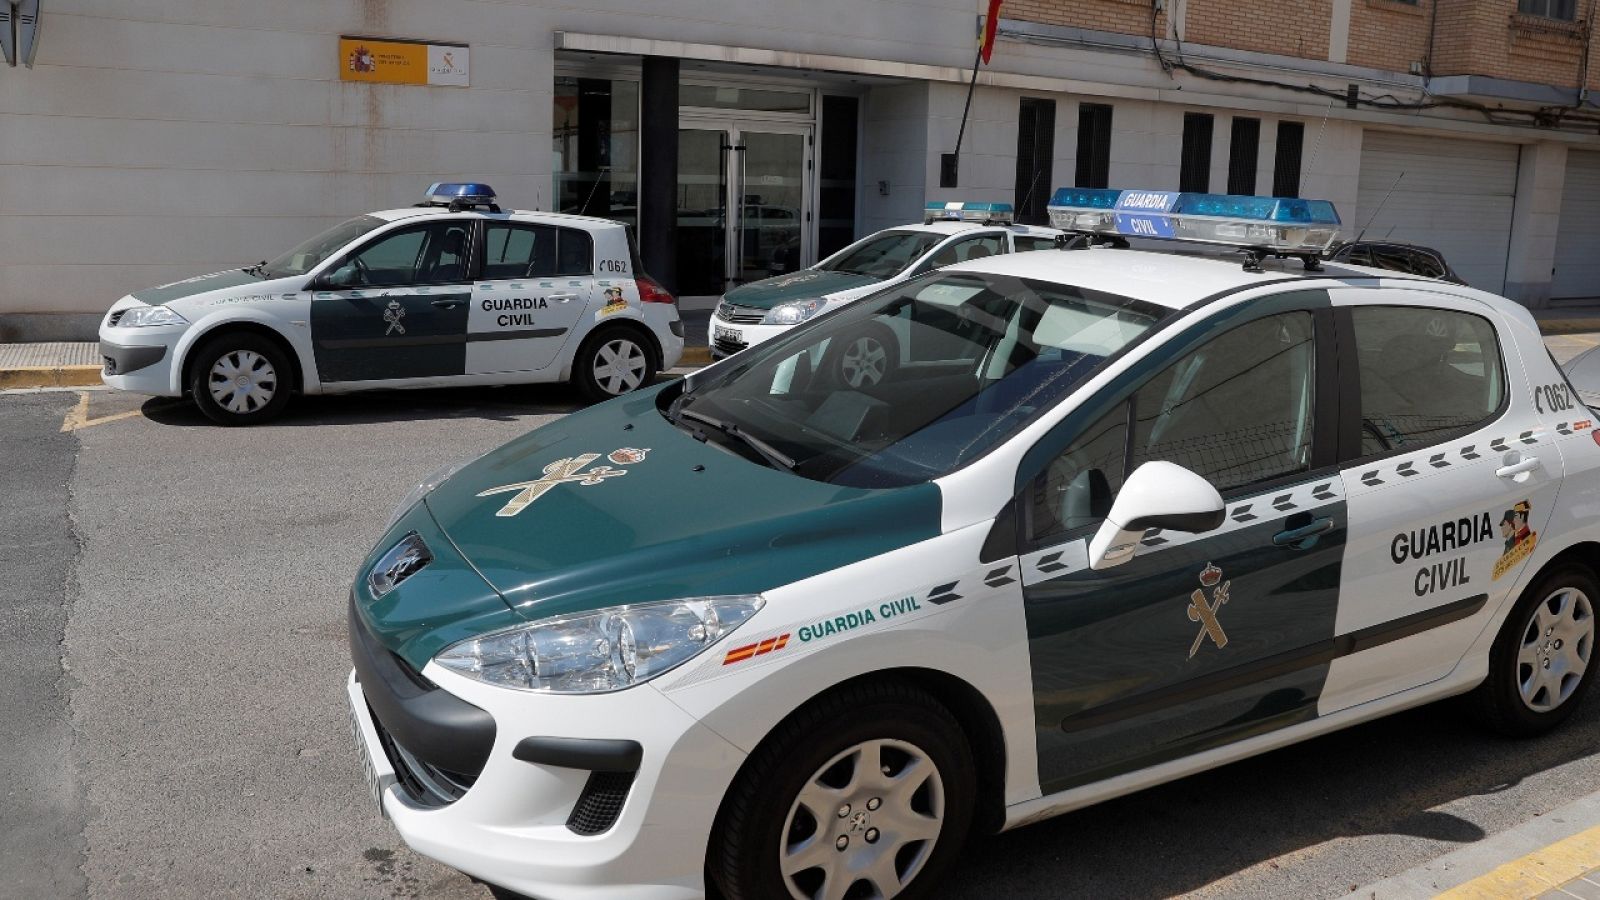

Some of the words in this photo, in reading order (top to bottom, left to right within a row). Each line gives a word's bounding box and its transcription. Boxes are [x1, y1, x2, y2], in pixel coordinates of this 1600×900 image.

[1124, 193, 1168, 209] GUARDIA
[1131, 218, 1158, 235] CIVIL
[608, 260, 627, 273] 062
[481, 297, 548, 311] GUARDIA
[497, 313, 535, 326] CIVIL
[1544, 383, 1574, 412] 062
[1391, 512, 1493, 564] GUARDIA
[1414, 557, 1470, 597] CIVIL
[798, 609, 876, 642] GUARDIA
[879, 596, 921, 618] CIVIL
